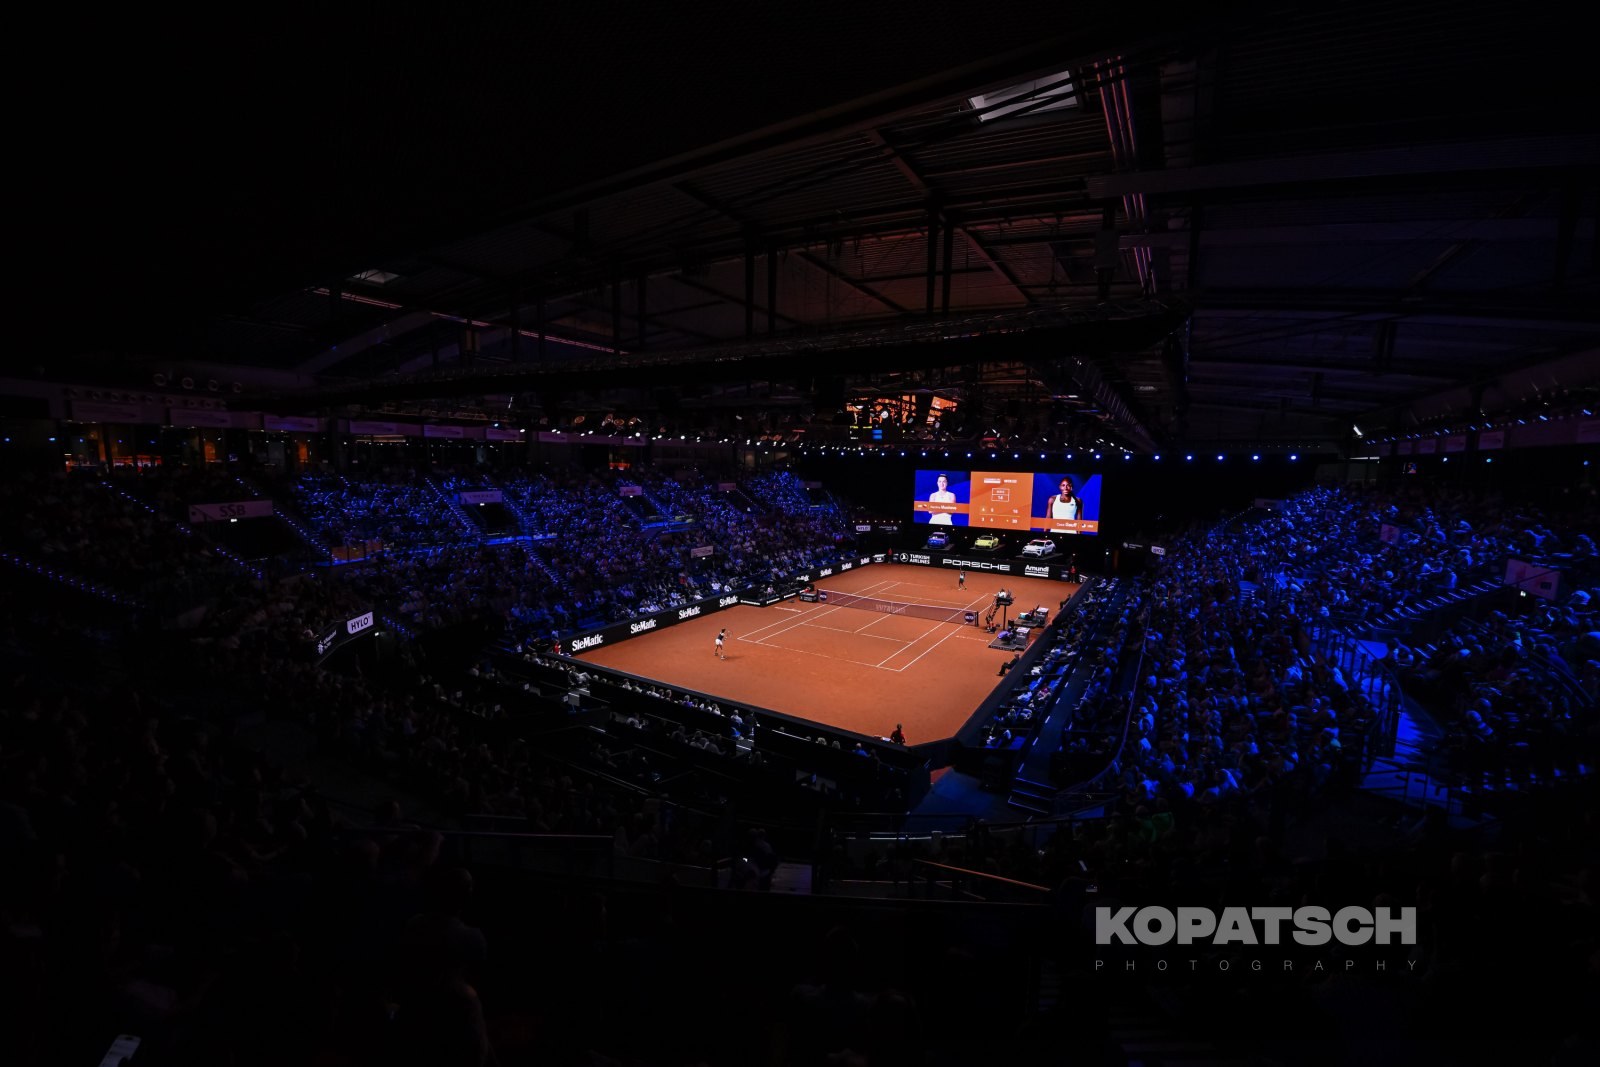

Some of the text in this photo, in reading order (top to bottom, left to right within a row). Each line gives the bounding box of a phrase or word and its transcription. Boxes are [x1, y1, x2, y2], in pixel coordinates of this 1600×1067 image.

[219, 504, 246, 517] SSB
[942, 558, 1011, 572] PORSCHE
[1025, 564, 1050, 572] Amundi
[678, 605, 701, 620] SieMatic
[351, 616, 369, 631] HYLO
[630, 618, 657, 634] SieMatic
[571, 633, 604, 652] SieMatic
